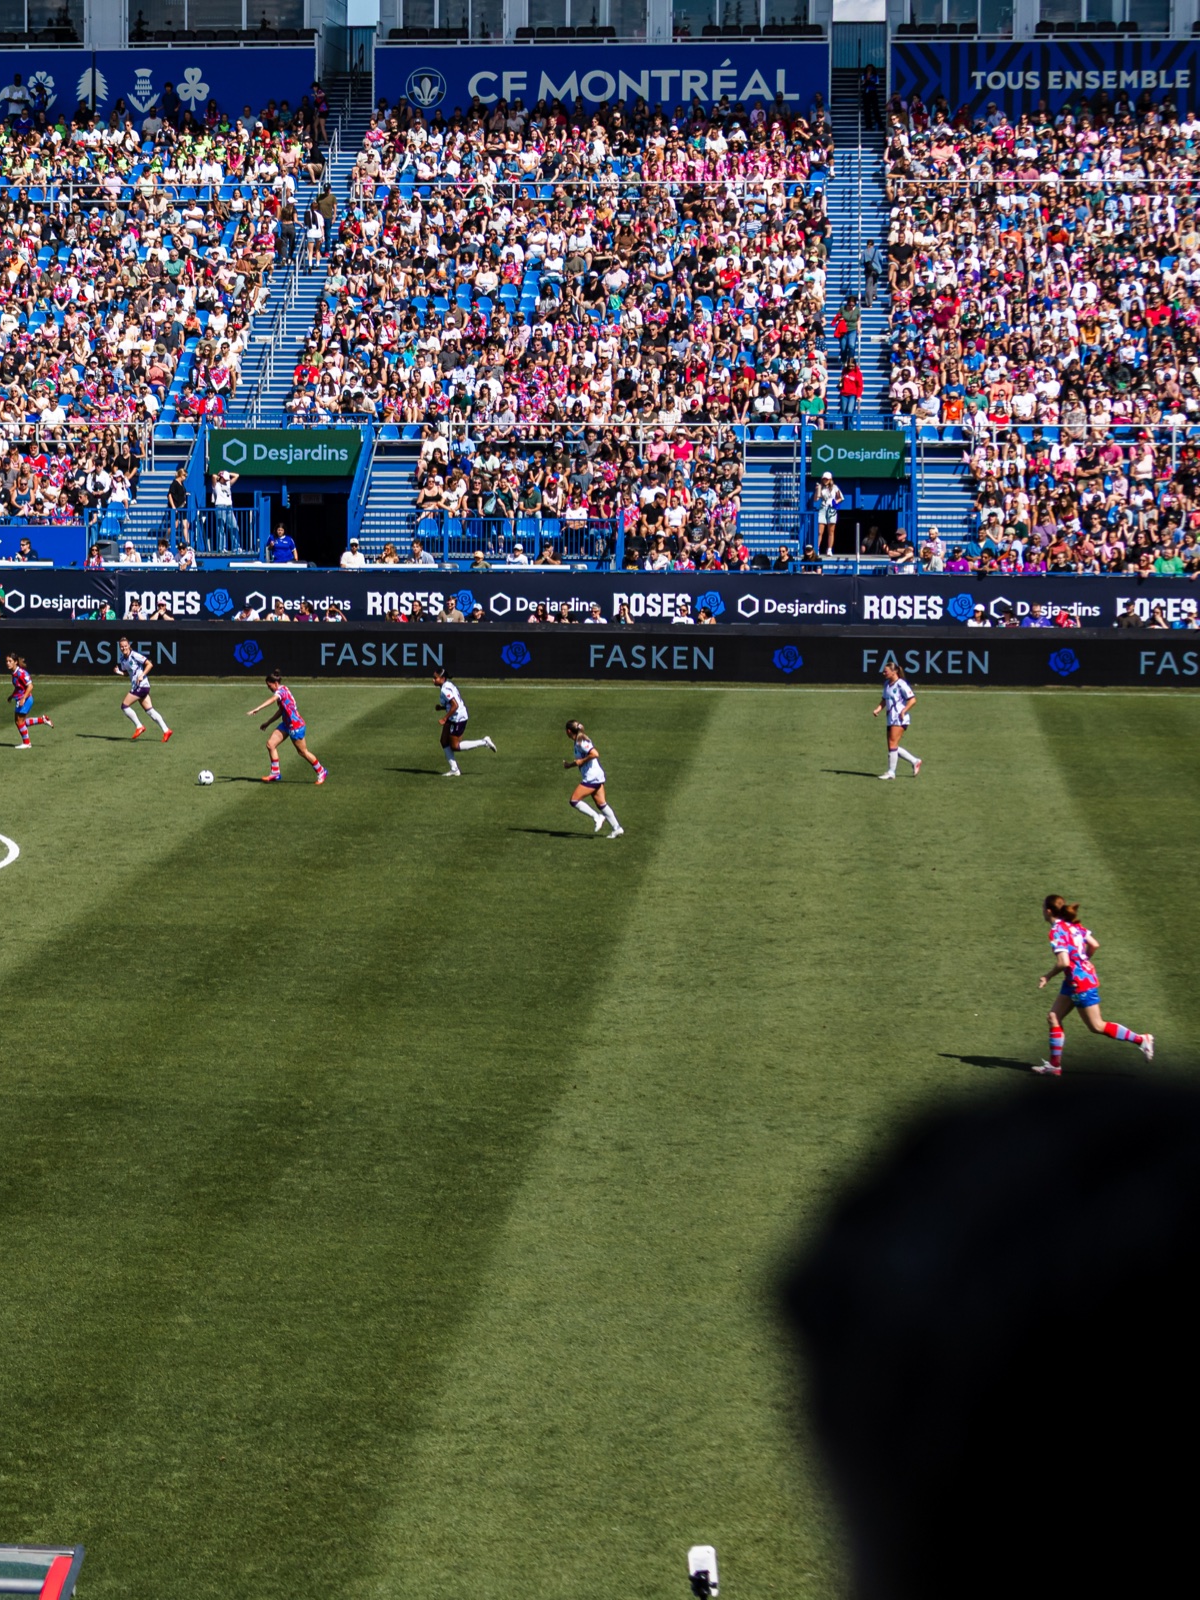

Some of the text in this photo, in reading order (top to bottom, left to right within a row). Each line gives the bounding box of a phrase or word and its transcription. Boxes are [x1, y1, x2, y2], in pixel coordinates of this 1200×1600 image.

[467, 57, 800, 103] CF MONTRÉAL
[971, 69, 1191, 90] TOUS ENSEMBLE
[253, 444, 349, 465] Desjardins
[837, 448, 901, 462] Desjardins
[764, 598, 847, 616] Desjardins
[863, 594, 944, 620] ROSES
[1016, 601, 1101, 619] Dsjadins
[320, 642, 444, 667] FASKEN
[589, 644, 714, 671] FASKEN
[862, 649, 990, 675] FASKEN
